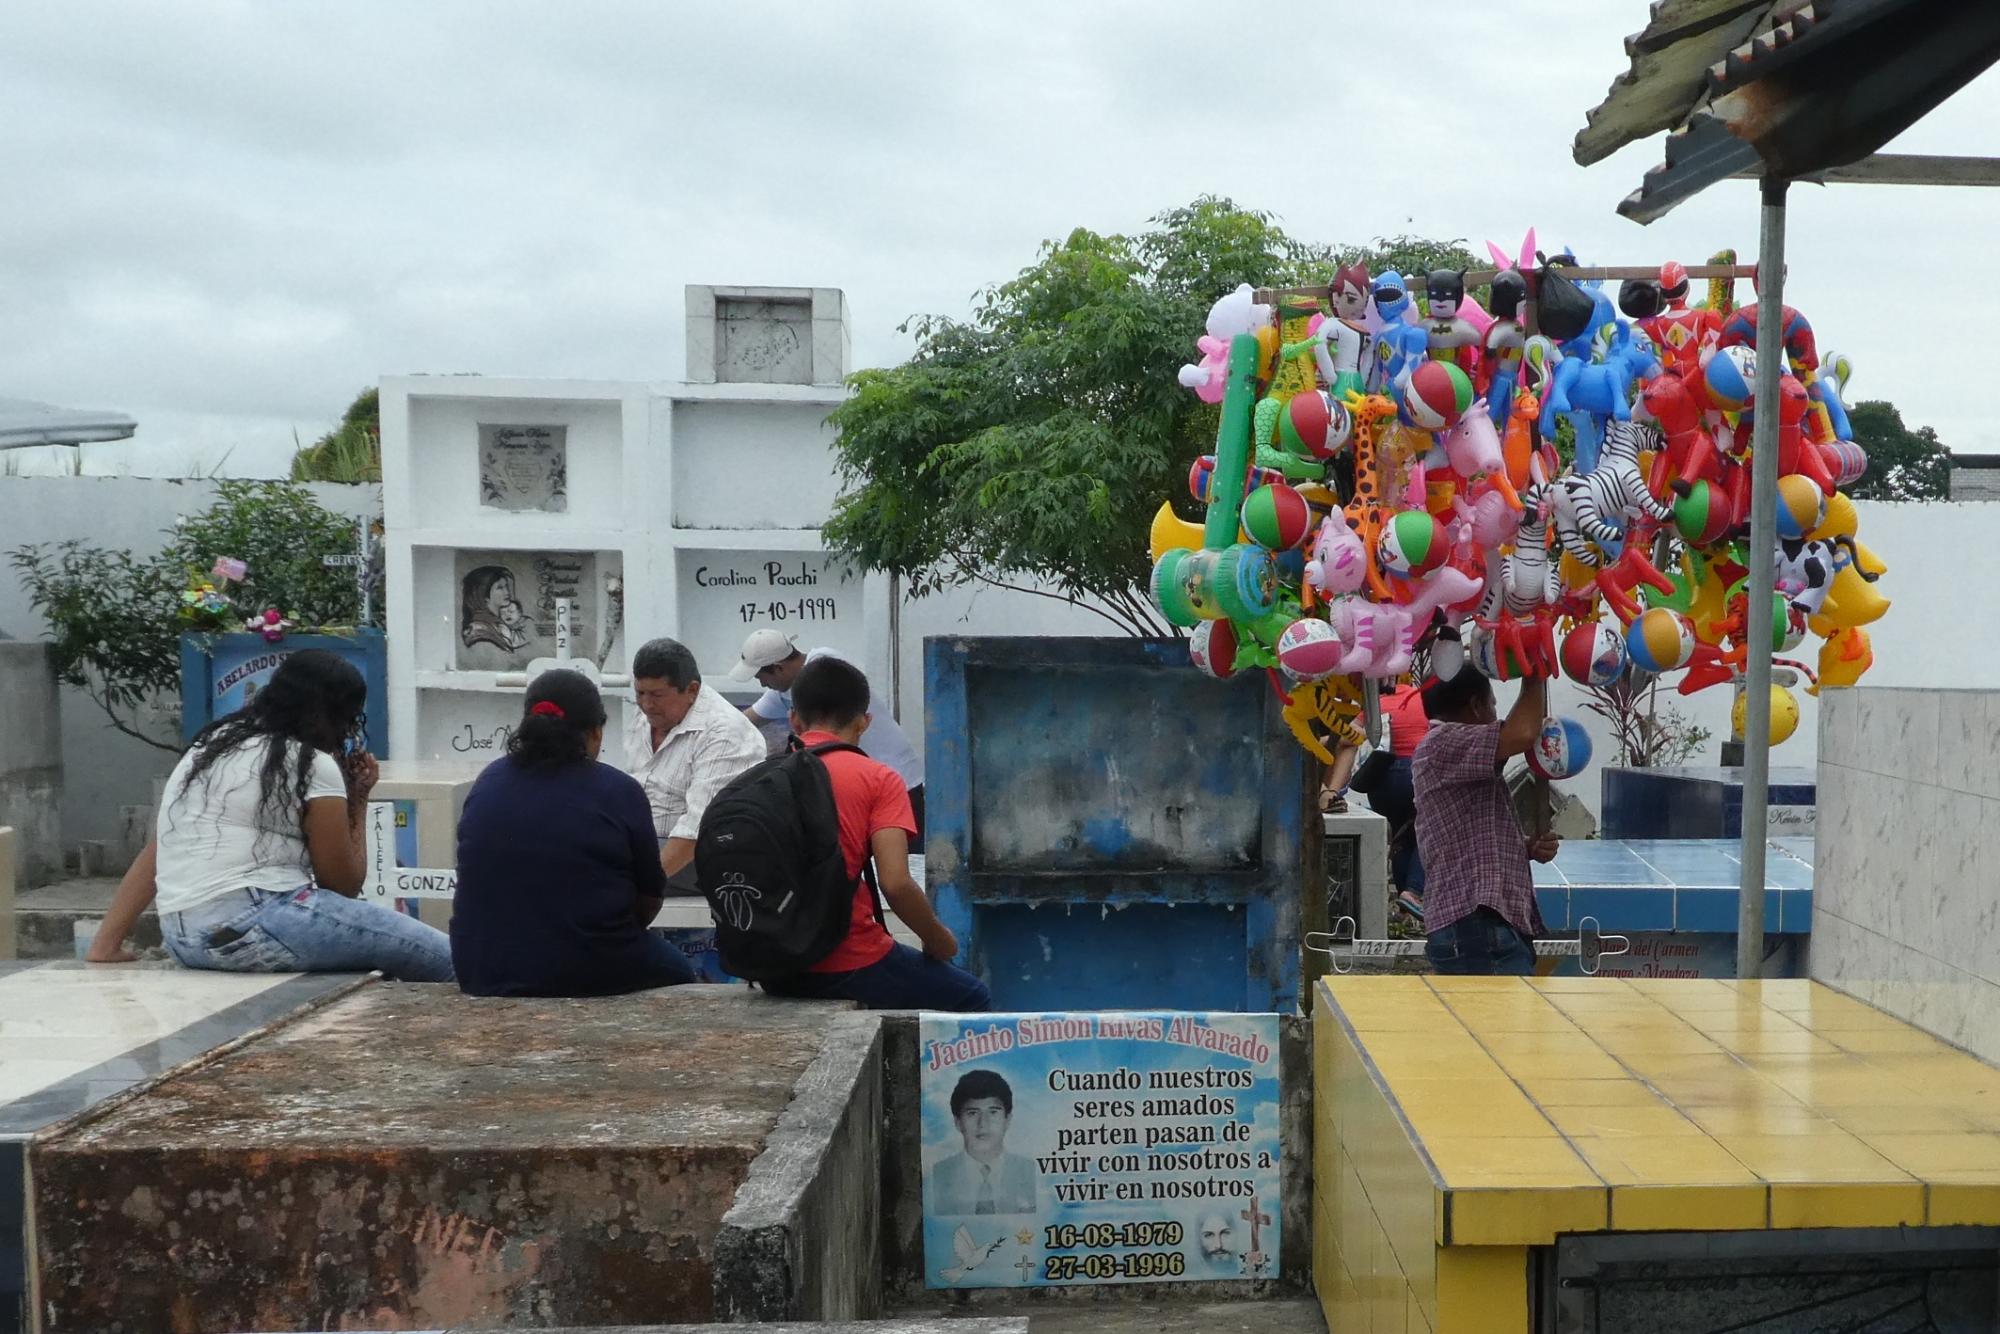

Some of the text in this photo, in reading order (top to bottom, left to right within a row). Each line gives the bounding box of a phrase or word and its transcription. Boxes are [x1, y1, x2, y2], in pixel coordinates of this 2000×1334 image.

[696, 561, 817, 587] Carolina Pauchi
[739, 598, 836, 623] 17-10-1999
[557, 606, 568, 648] PAZ
[216, 654, 277, 695] ABELARDO
[451, 724, 493, 752] José
[1768, 808, 1801, 825] Kevin
[1654, 940, 1699, 961] Carmen
[929, 1016, 1269, 1071] Jacinto Simon Rivas Alvarado
[1049, 1066, 1252, 1091] Cuando nuestros
[1073, 1095, 1234, 1118] seres amados
[1058, 1121, 1250, 1150] parten pasan de
[1036, 1149, 1271, 1173] vivir con nosotros a
[1055, 1176, 1254, 1201] vivir en nosotros
[1045, 1221, 1183, 1249] 16-08-1979
[1046, 1252, 1185, 1280] 27-03-1996
